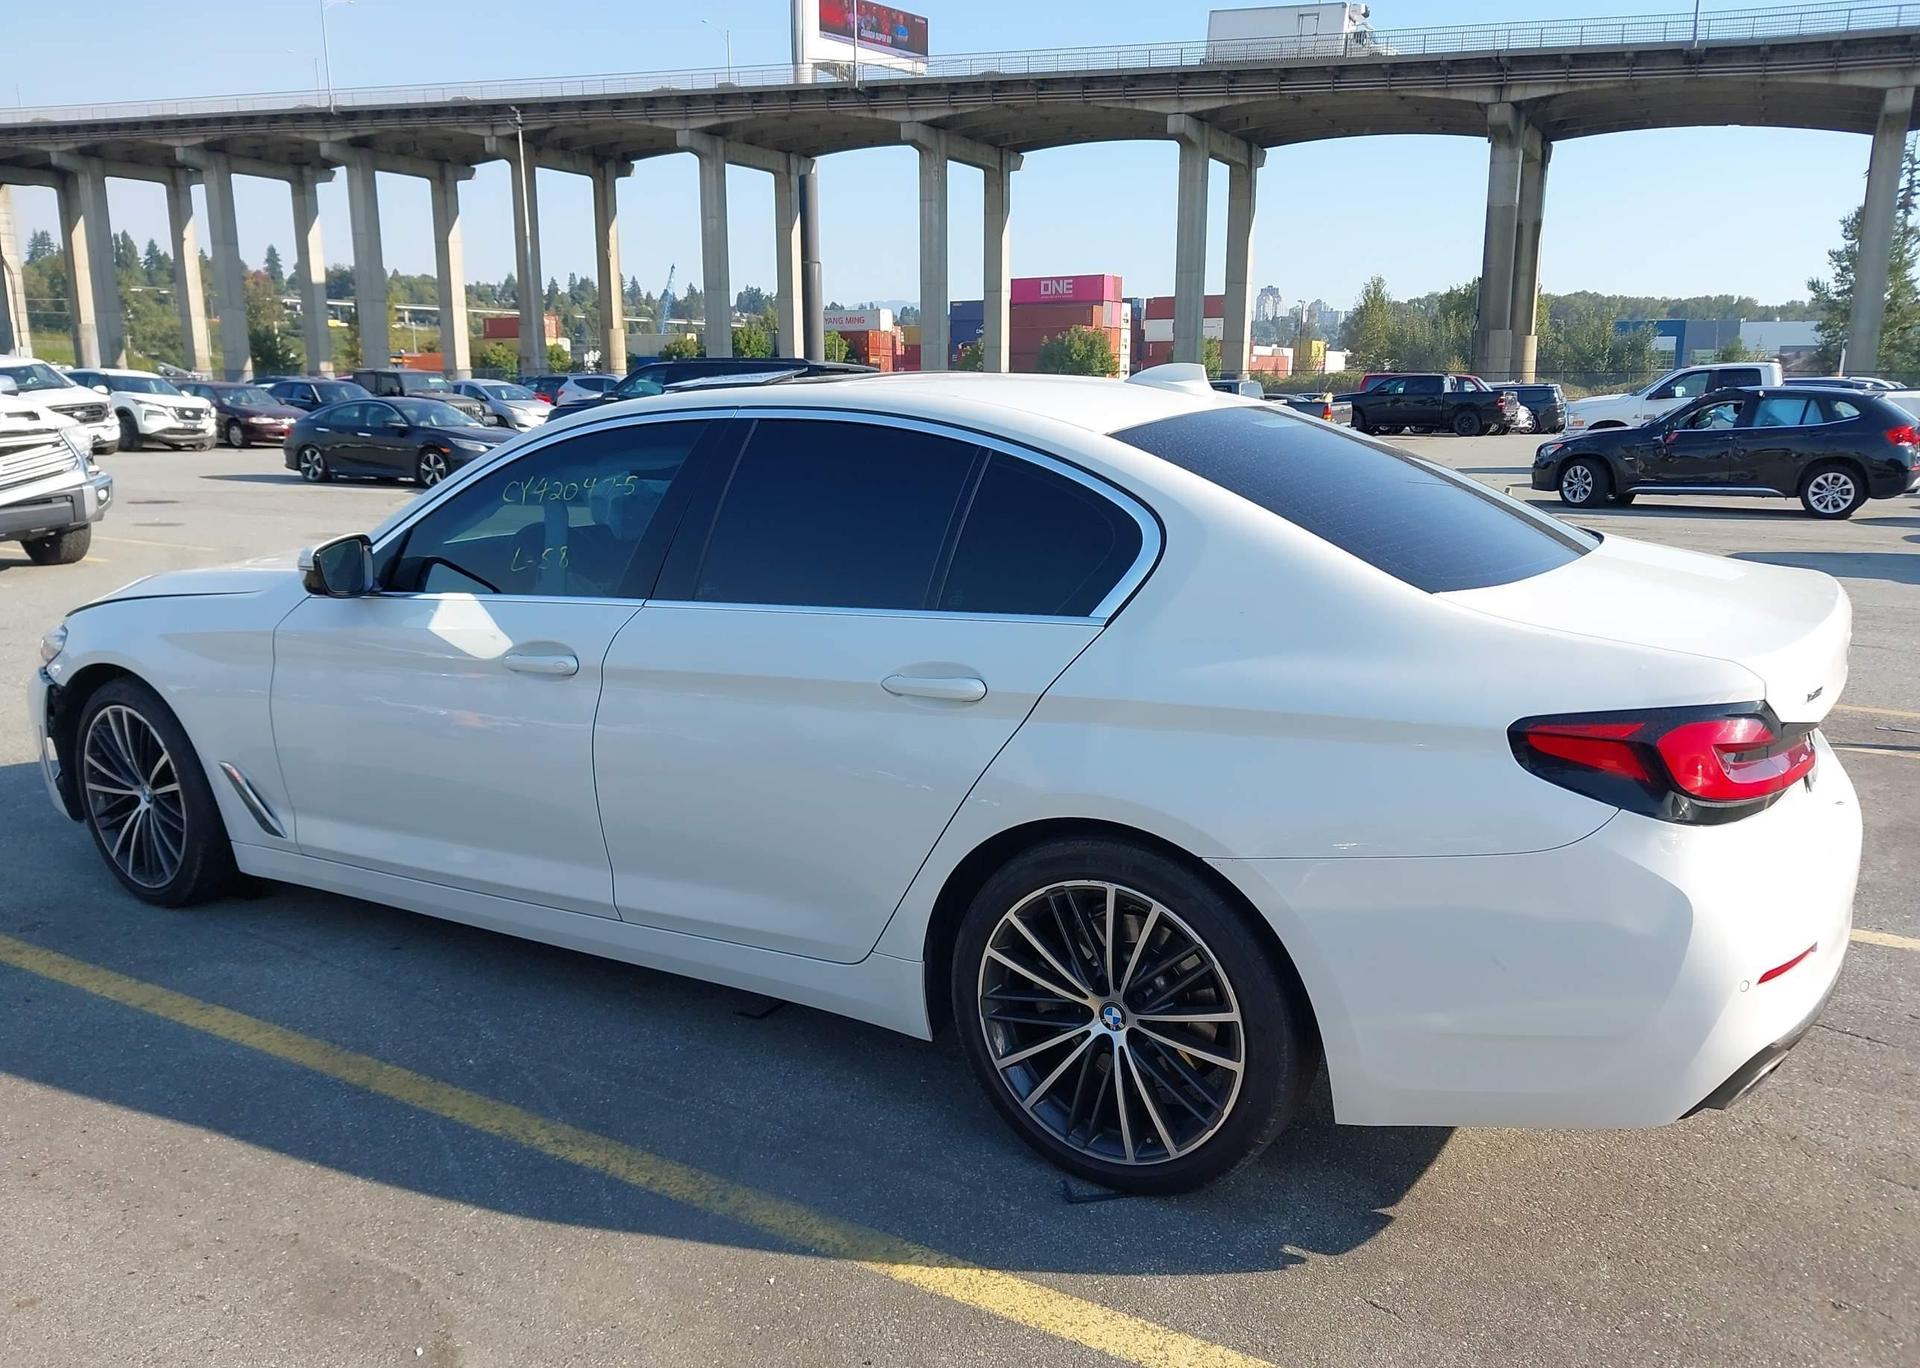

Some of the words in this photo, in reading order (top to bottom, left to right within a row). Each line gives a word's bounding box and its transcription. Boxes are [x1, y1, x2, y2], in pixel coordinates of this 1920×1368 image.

[1040, 279, 1073, 295] ONE
[824, 316, 844, 325] YANG
[845, 316, 865, 325] MING
